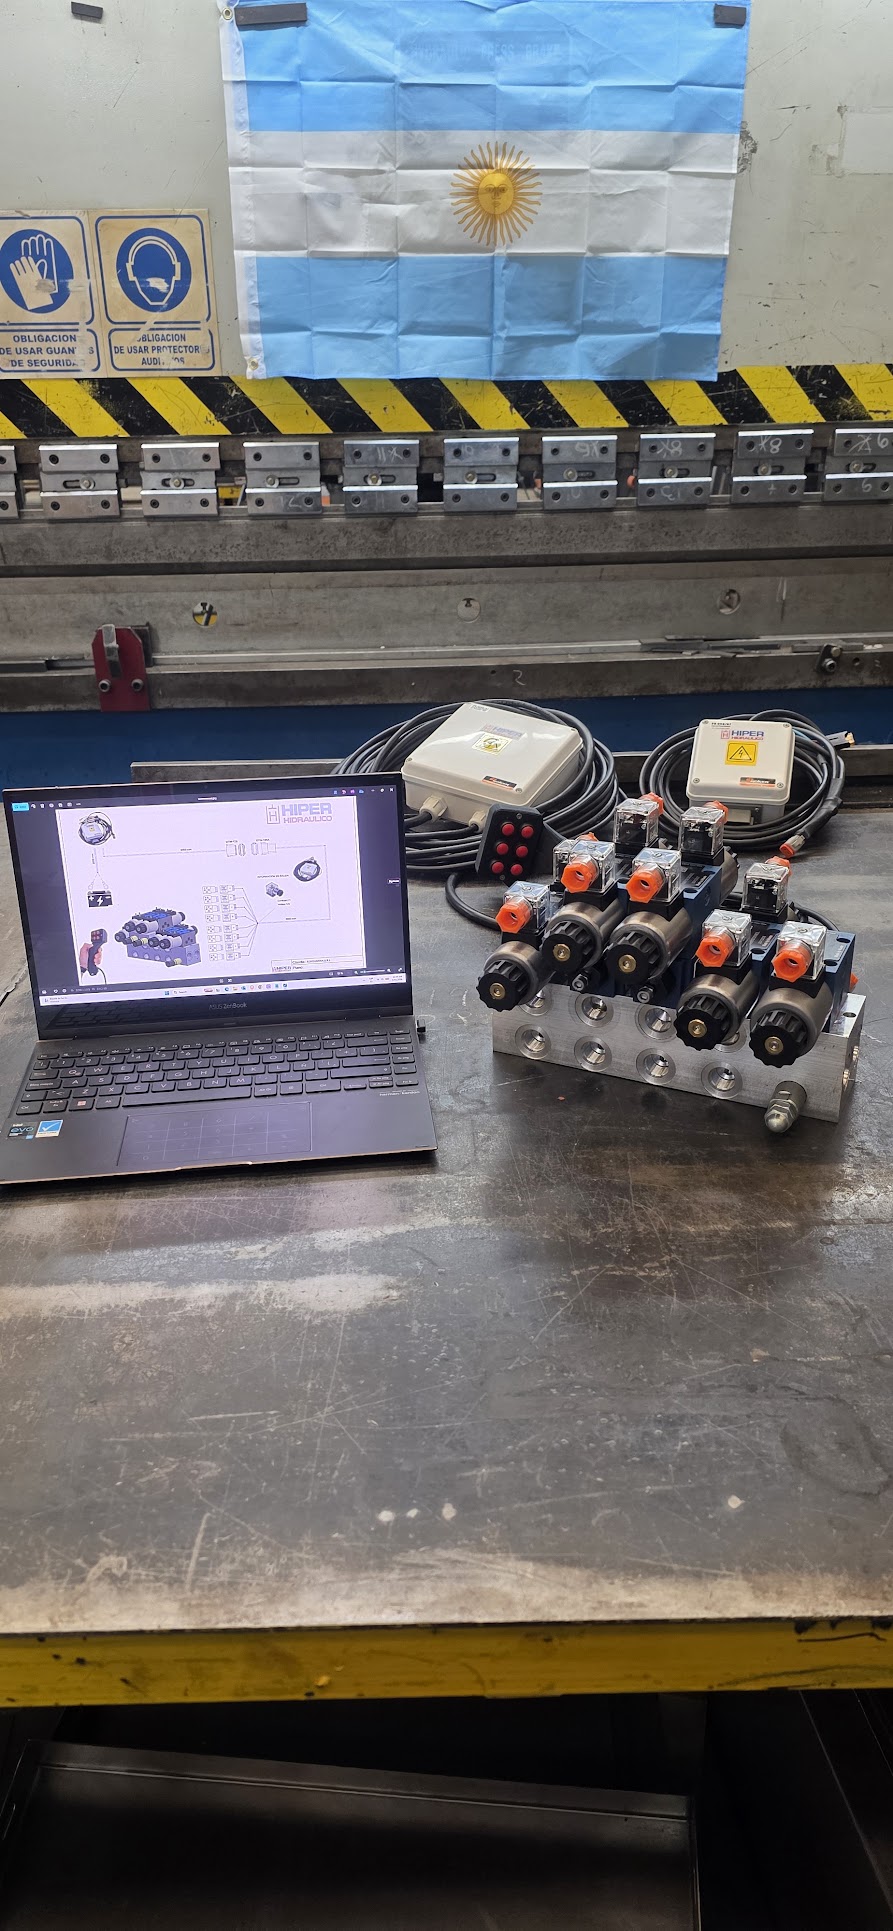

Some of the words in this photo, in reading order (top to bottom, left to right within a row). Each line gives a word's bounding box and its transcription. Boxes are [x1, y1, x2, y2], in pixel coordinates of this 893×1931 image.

[12, 334, 77, 343] OBLIGACION
[137, 333, 187, 342] BLIGACION
[0, 347, 12, 355] DE
[15, 347, 43, 355] USAR
[46, 347, 95, 355] GUANS
[113, 346, 125, 354] DE
[127, 345, 149, 354] USAR
[151, 345, 210, 354] PROTECTOR
[10, 359, 24, 367] DE
[27, 359, 82, 367] SEGURID
[281, 802, 332, 817] HIPER
[283, 815, 333, 824] HIDRAULICO
